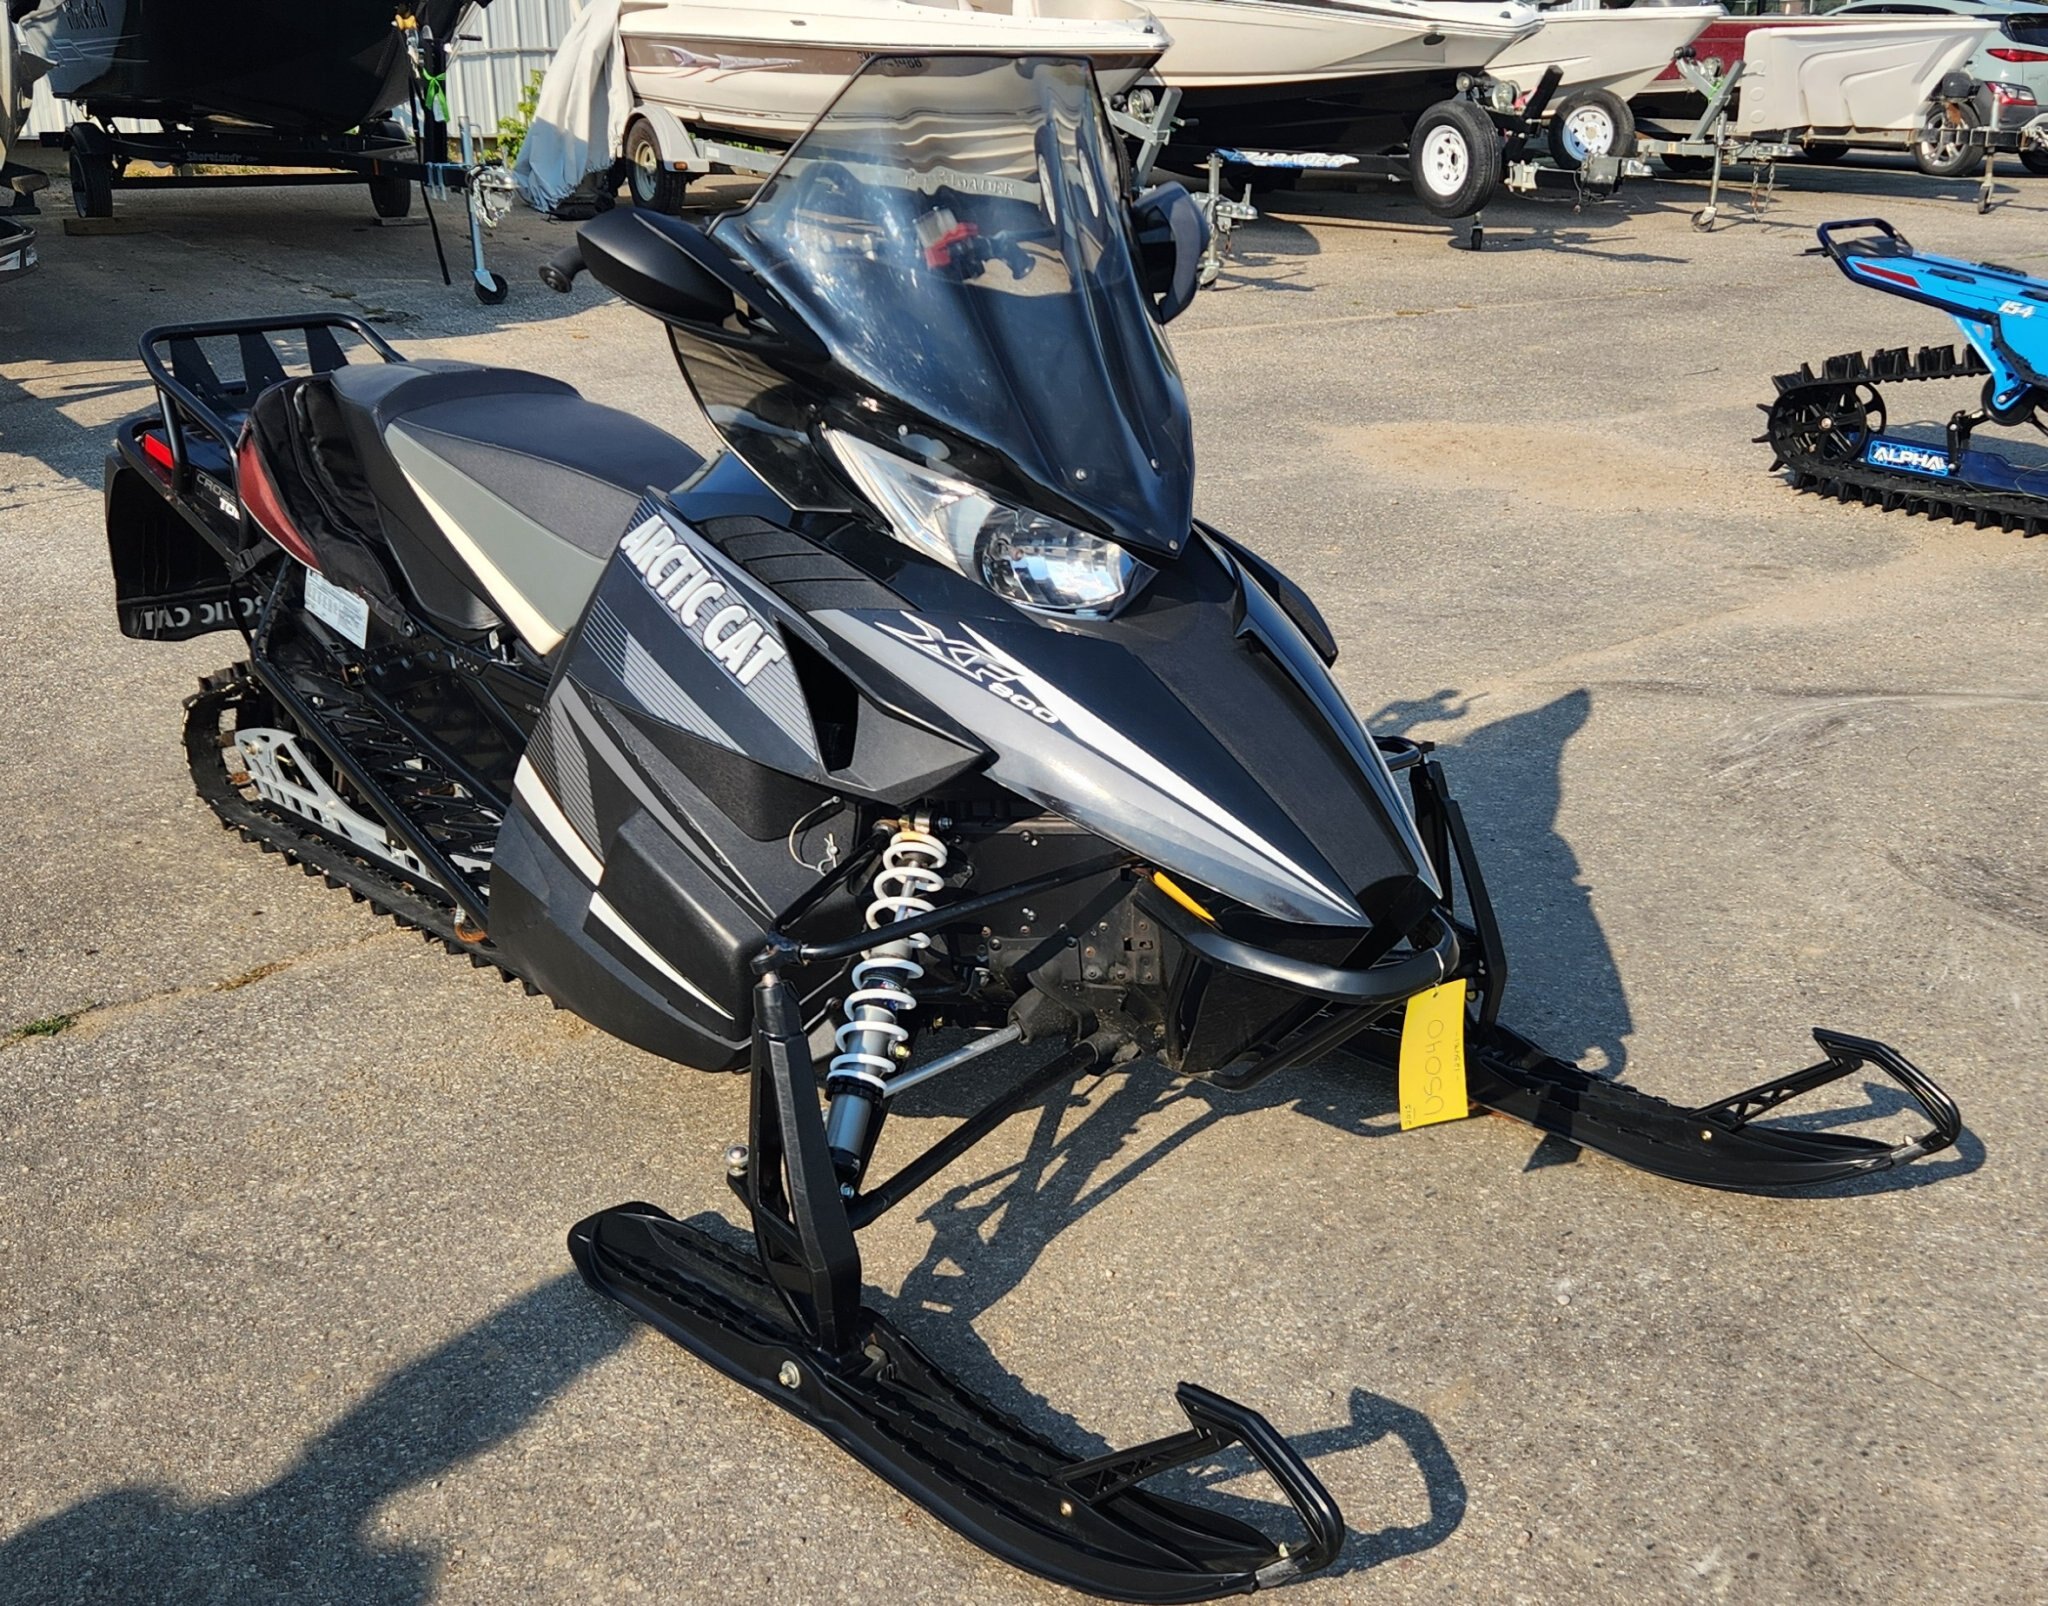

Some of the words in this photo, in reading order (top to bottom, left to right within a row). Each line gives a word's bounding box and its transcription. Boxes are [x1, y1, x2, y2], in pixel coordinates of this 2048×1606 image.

[1997, 299, 2036, 319] 154
[1873, 446, 1947, 471] ALPHA
[619, 513, 727, 627] ARCTIC
[702, 604, 787, 686] CAT
[987, 682, 1060, 725] 800
